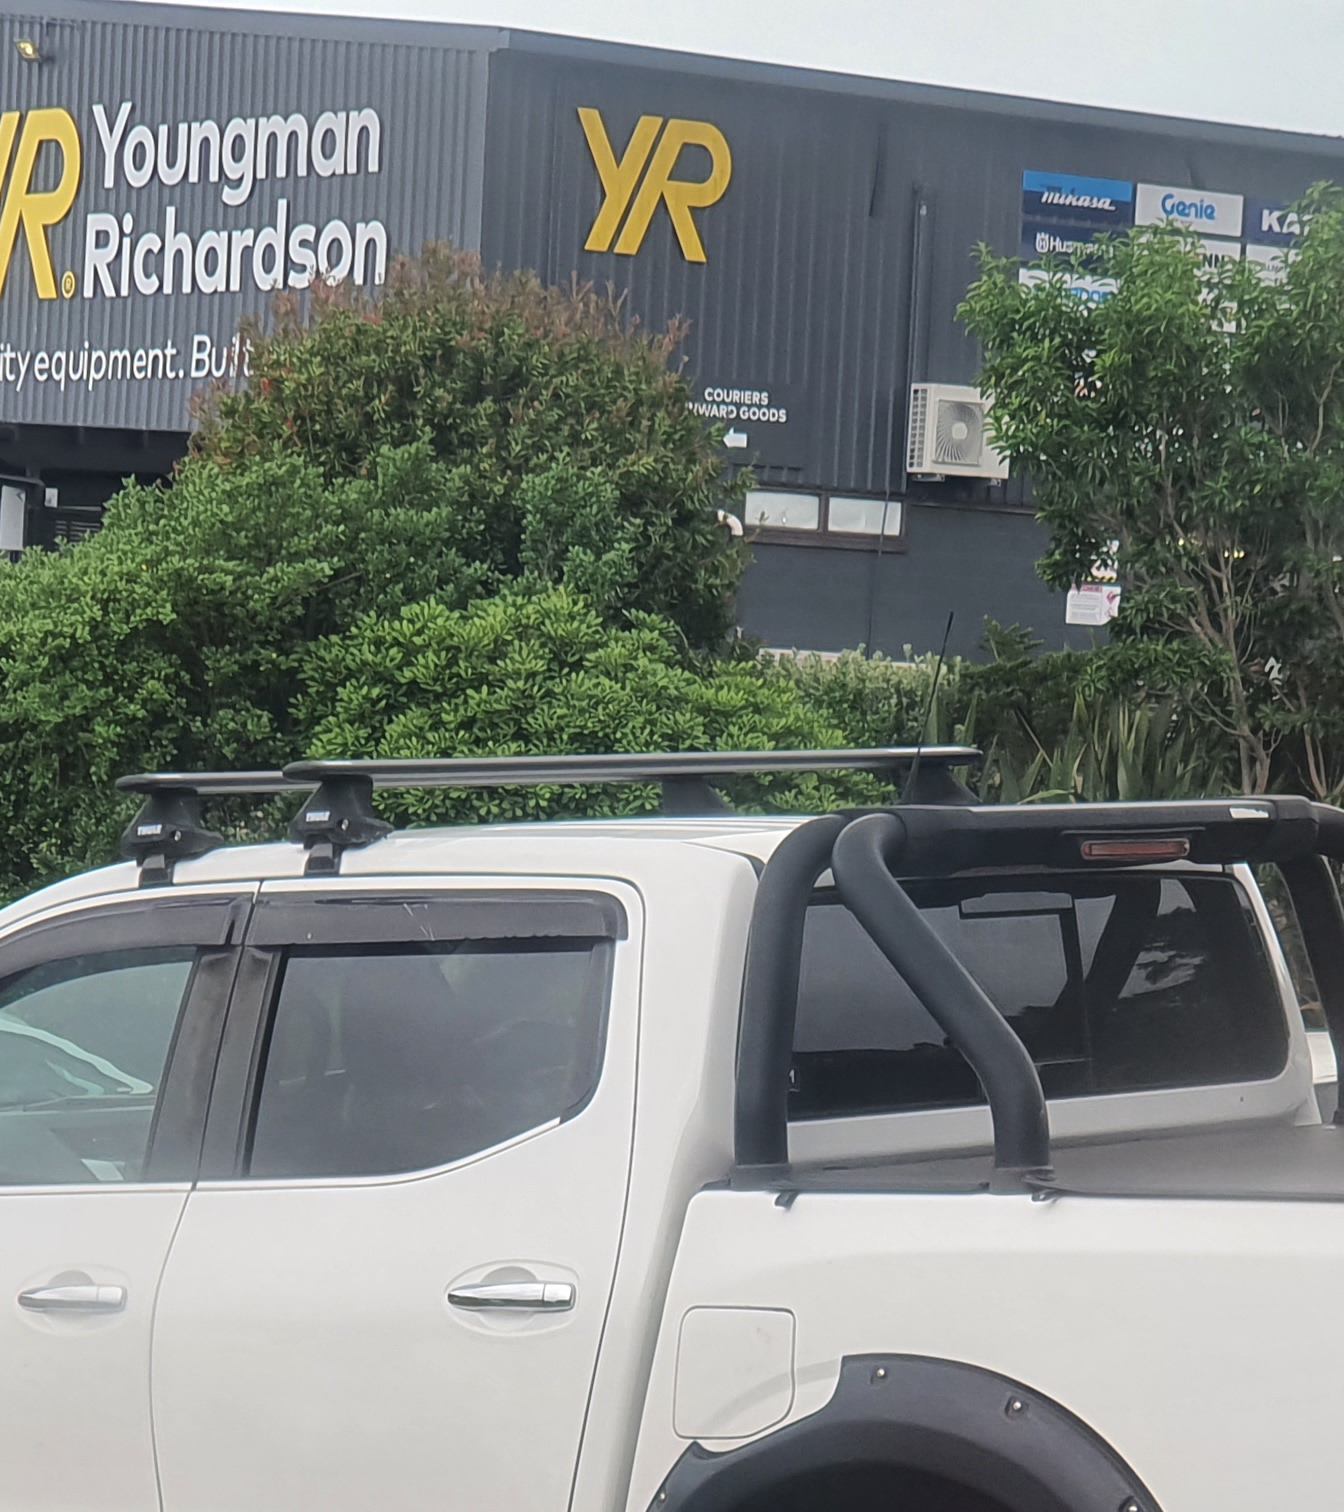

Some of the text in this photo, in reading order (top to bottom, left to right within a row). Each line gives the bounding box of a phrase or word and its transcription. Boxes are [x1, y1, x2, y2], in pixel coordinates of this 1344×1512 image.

[92, 101, 381, 206] Youngman
[1161, 193, 1216, 221] Genie
[83, 199, 388, 298] Richardson
[33, 339, 185, 391] equipment.
[686, 401, 787, 423] NWARD GOODS
[704, 386, 769, 406] COURIERS
